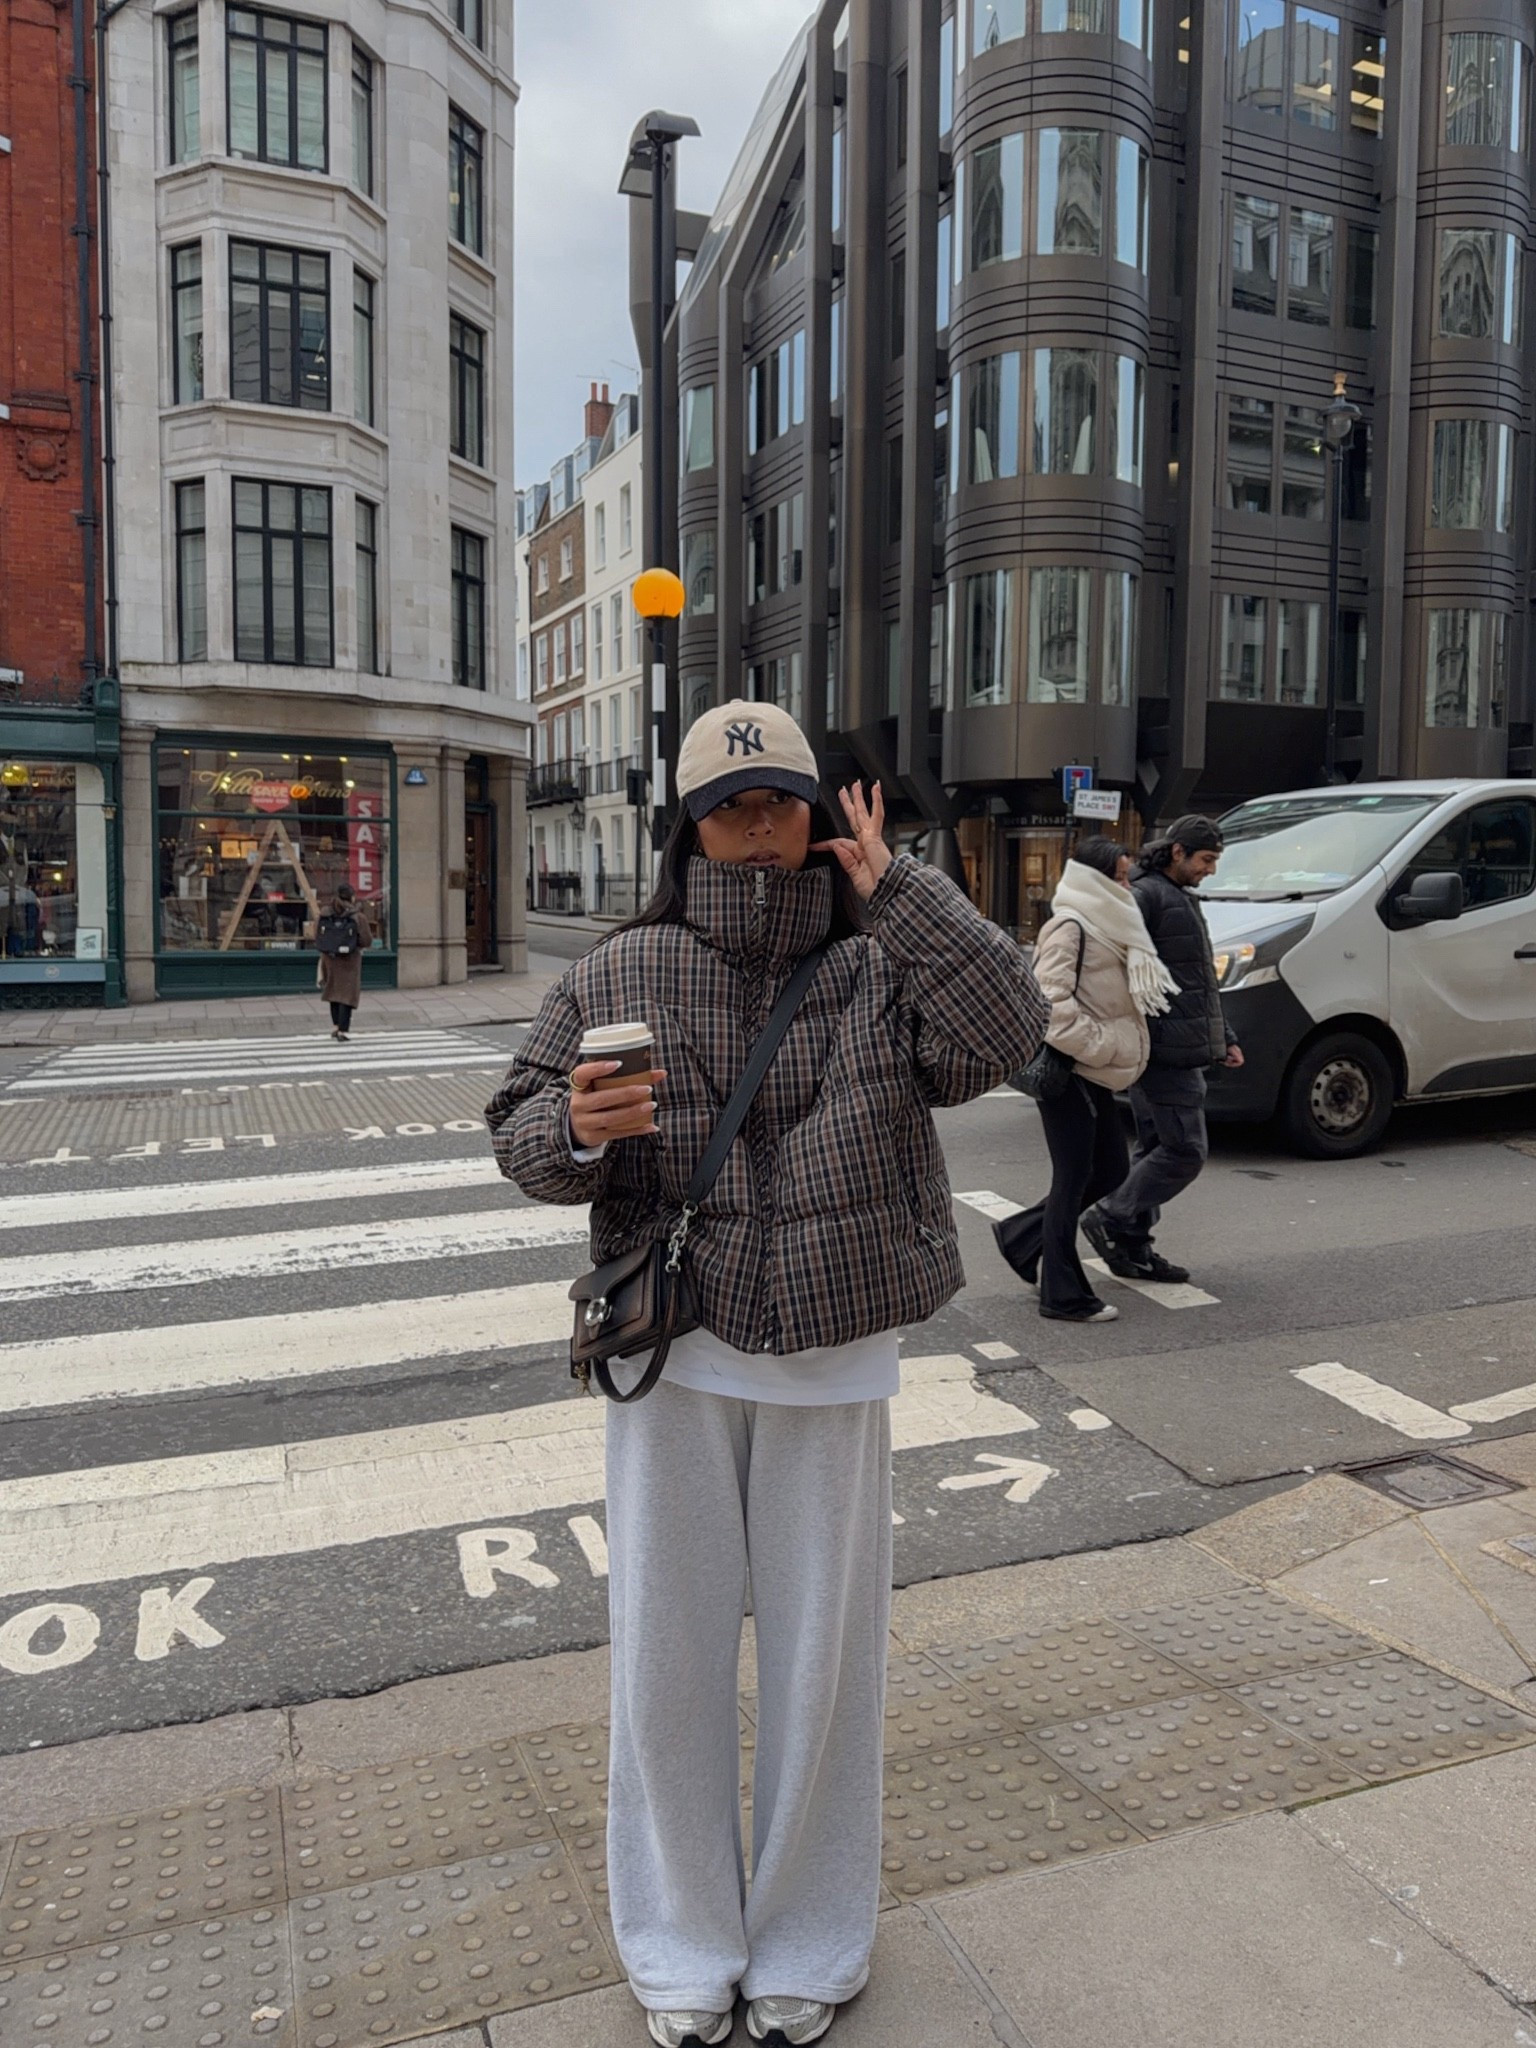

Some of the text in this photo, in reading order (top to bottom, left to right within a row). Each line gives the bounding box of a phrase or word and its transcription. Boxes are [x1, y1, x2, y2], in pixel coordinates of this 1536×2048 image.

[724, 722, 765, 757] NY
[1077, 801, 1099, 809] PLACE
[356, 800, 374, 891] SALE
[28, 1119, 487, 1167] OOK LEFT
